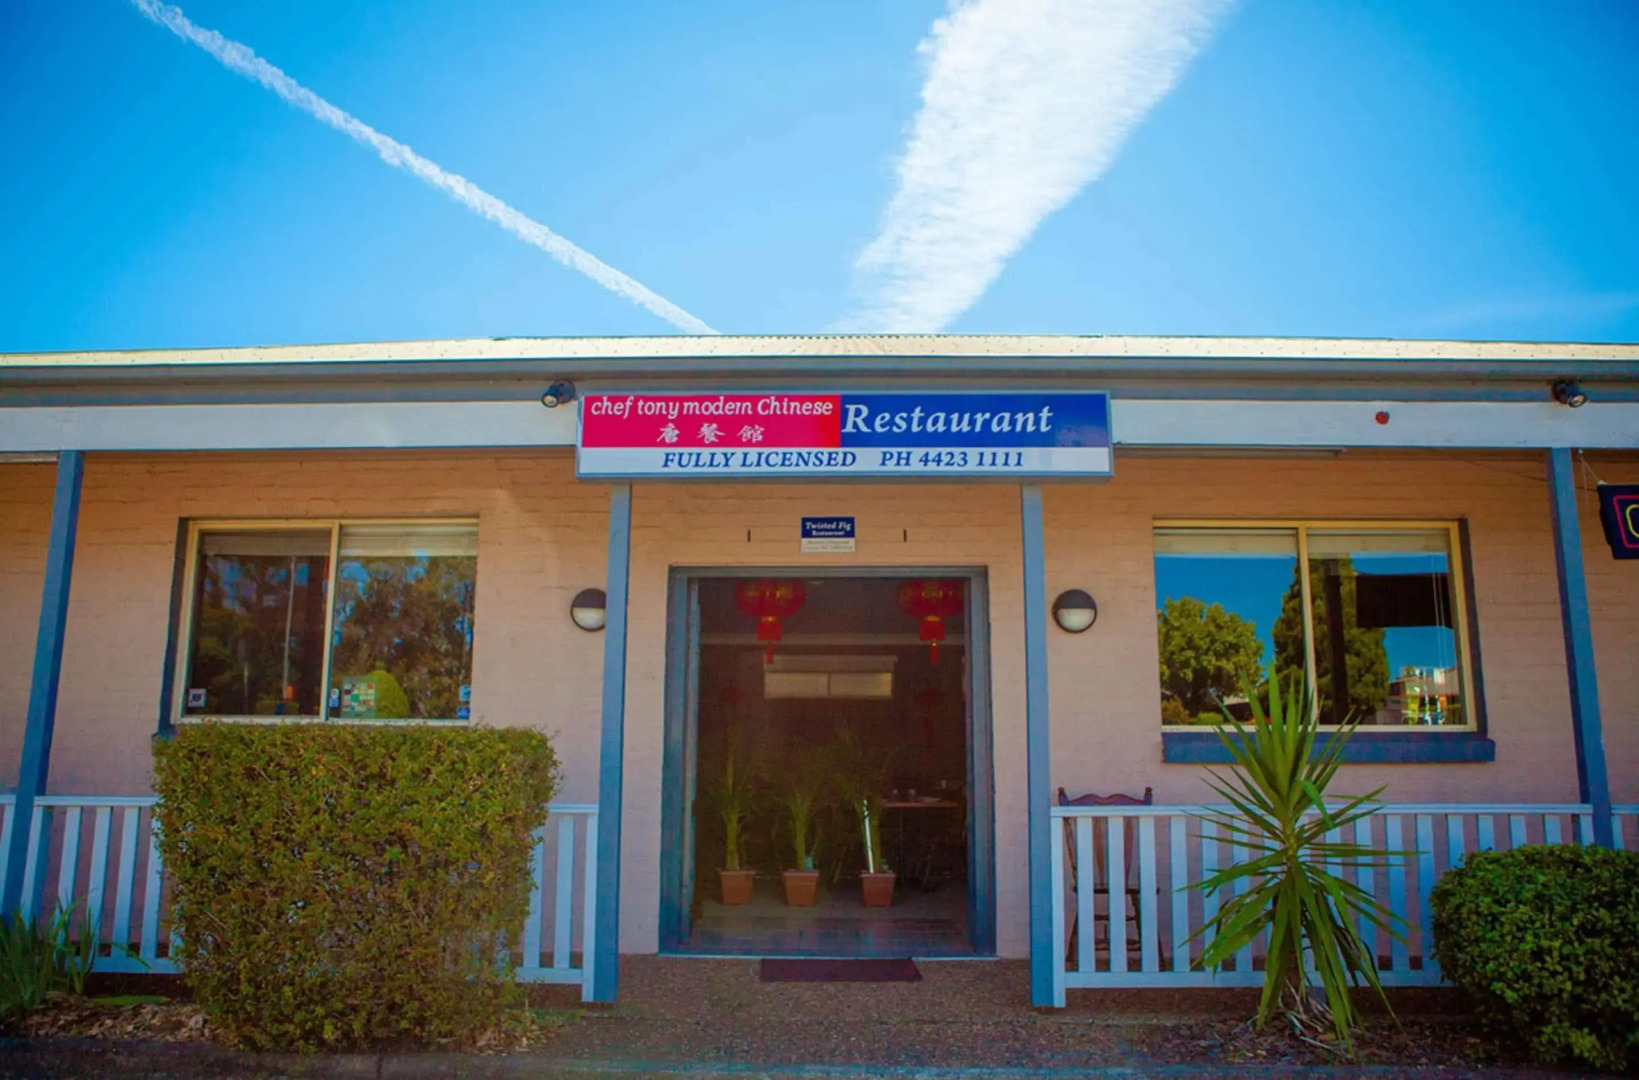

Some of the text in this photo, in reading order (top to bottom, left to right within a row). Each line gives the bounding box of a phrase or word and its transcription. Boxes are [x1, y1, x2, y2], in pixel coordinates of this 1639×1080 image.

[591, 396, 833, 419] chef tony modern Chinese
[841, 404, 1054, 433] Restaurant
[661, 452, 857, 468] FULLY LICENSED
[879, 451, 1023, 467] PH 4423 1111
